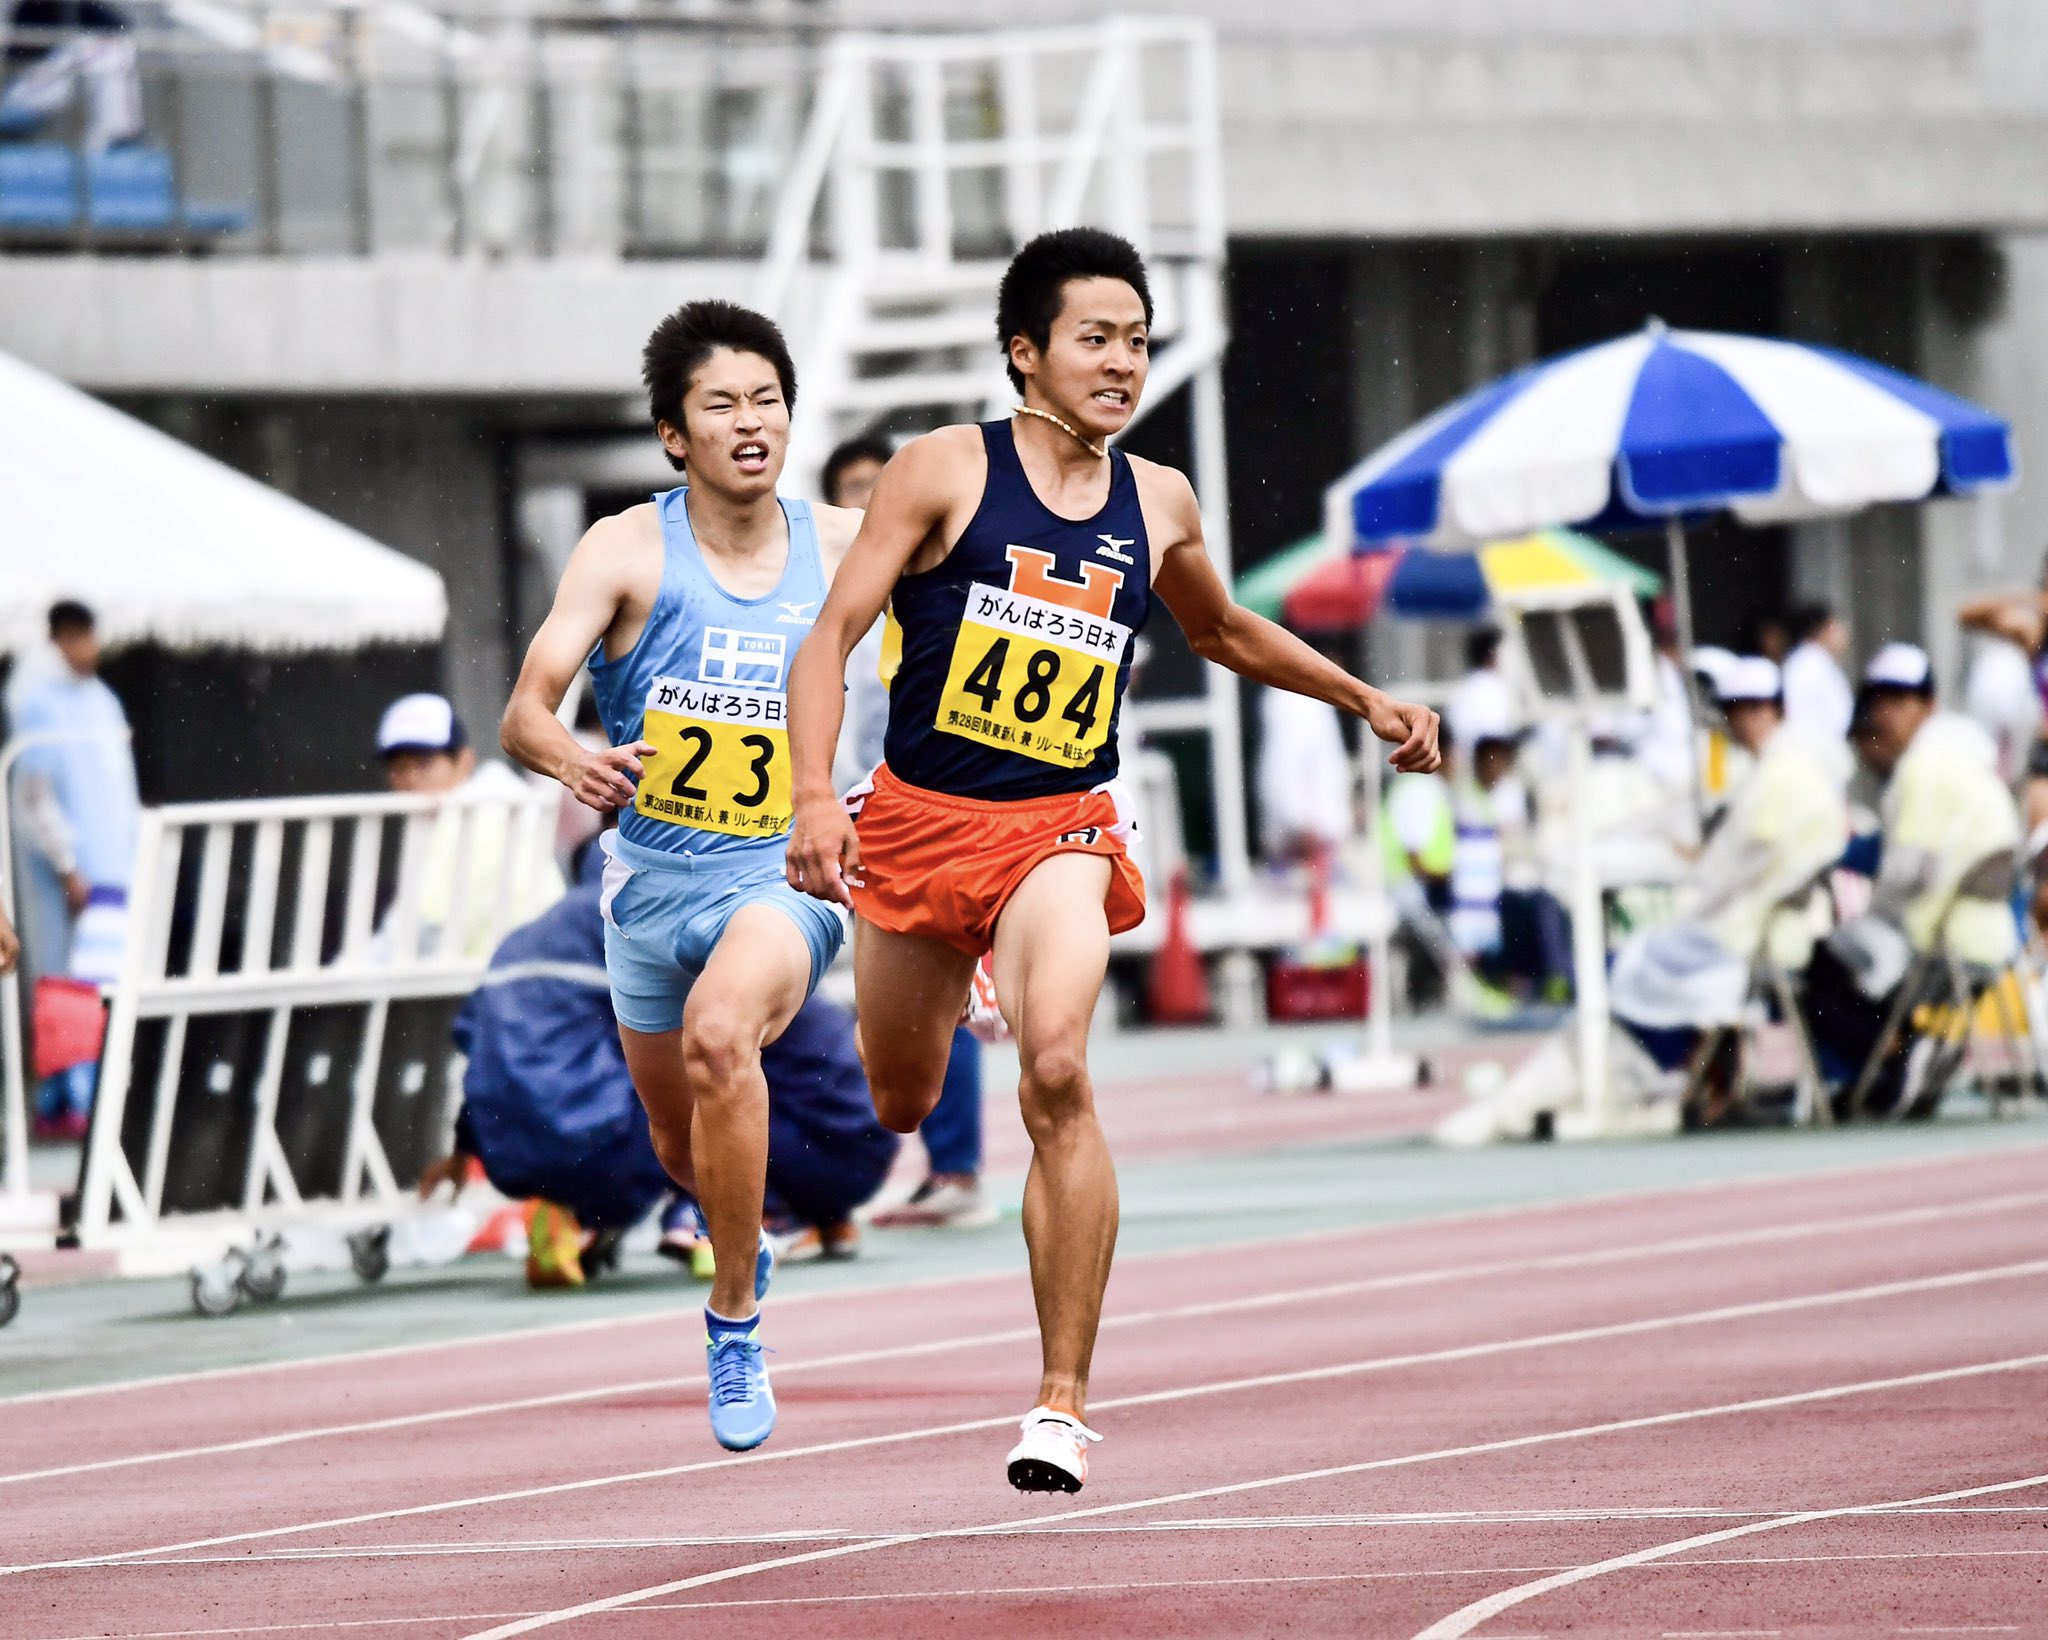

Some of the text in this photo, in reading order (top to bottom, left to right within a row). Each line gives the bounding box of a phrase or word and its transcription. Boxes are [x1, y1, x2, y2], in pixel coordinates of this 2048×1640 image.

[977, 593, 1118, 652] がんばろう日本
[743, 640, 776, 652] TOKAI
[657, 685, 787, 721] がんばろう日
[963, 636, 1105, 740] 484
[947, 710, 1016, 744] 第28回関東新人
[671, 725, 775, 808] 23
[643, 792, 715, 823] 第28回関東新人
